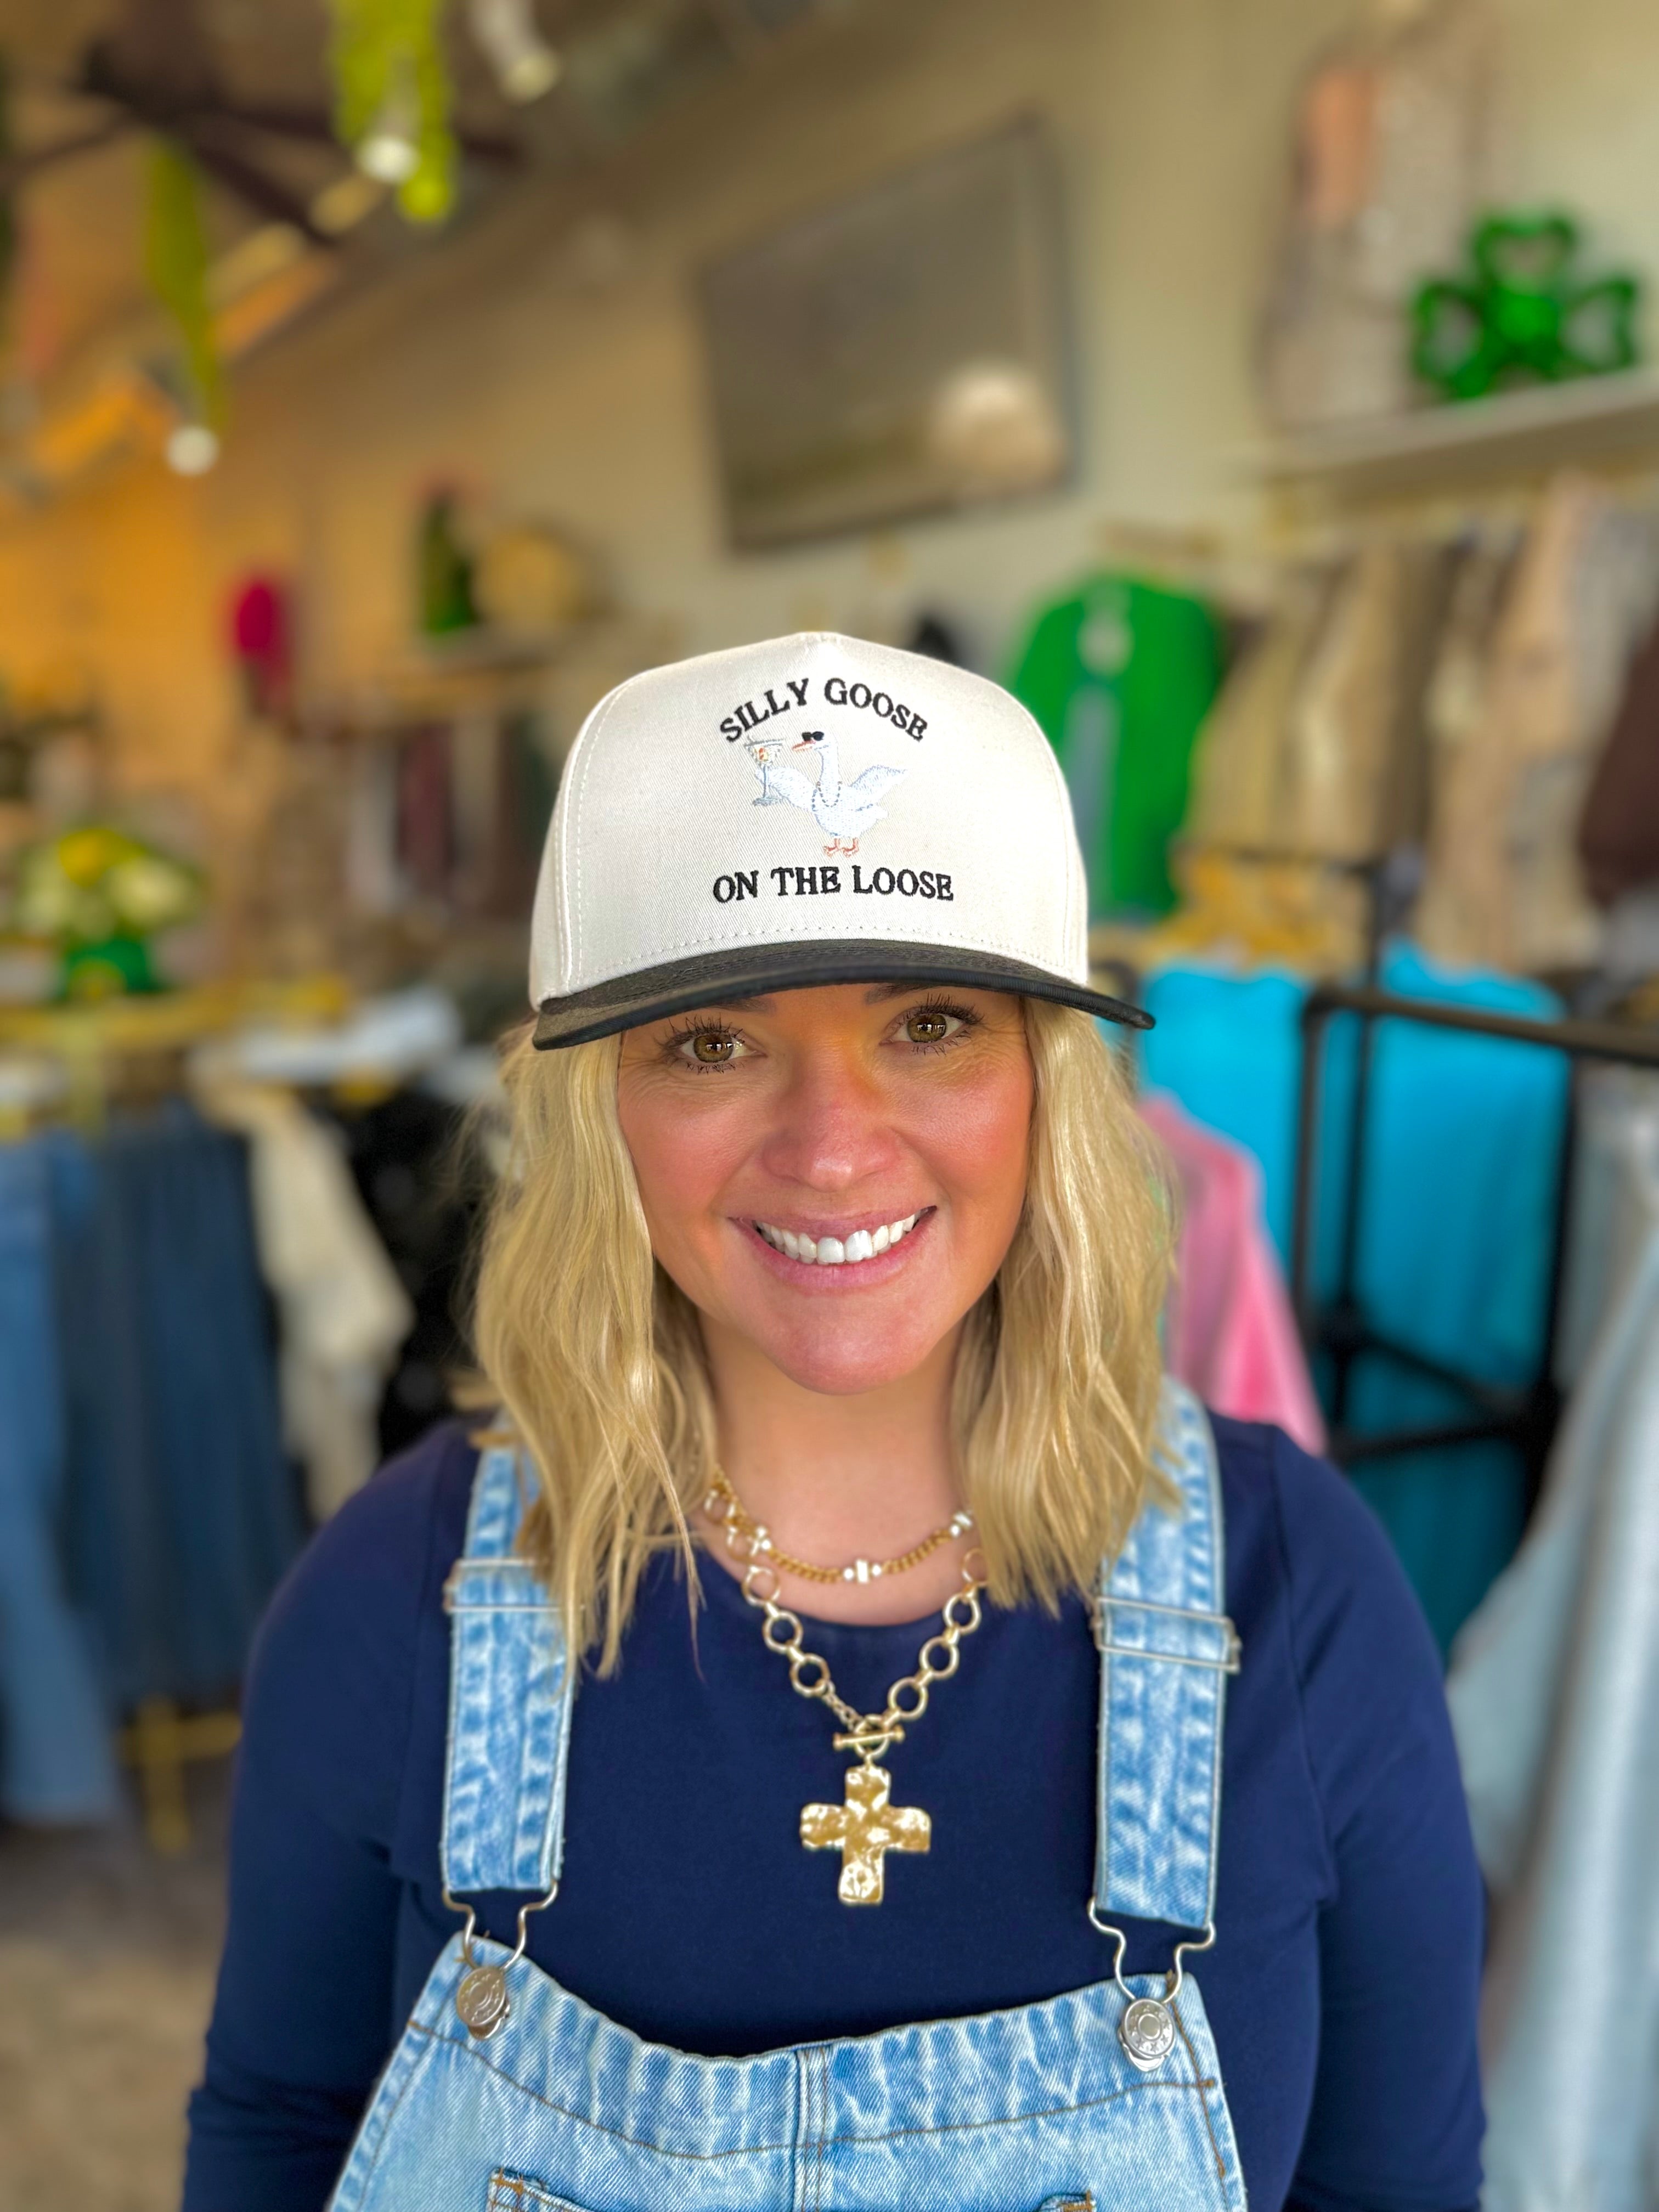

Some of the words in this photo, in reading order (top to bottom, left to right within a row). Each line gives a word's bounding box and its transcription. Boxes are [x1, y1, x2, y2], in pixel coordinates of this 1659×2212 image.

[720, 678, 809, 743] SILLY
[824, 678, 928, 742] GOOSE
[713, 870, 759, 903] ON
[771, 866, 841, 896] THE
[852, 865, 953, 901] LOOSE
